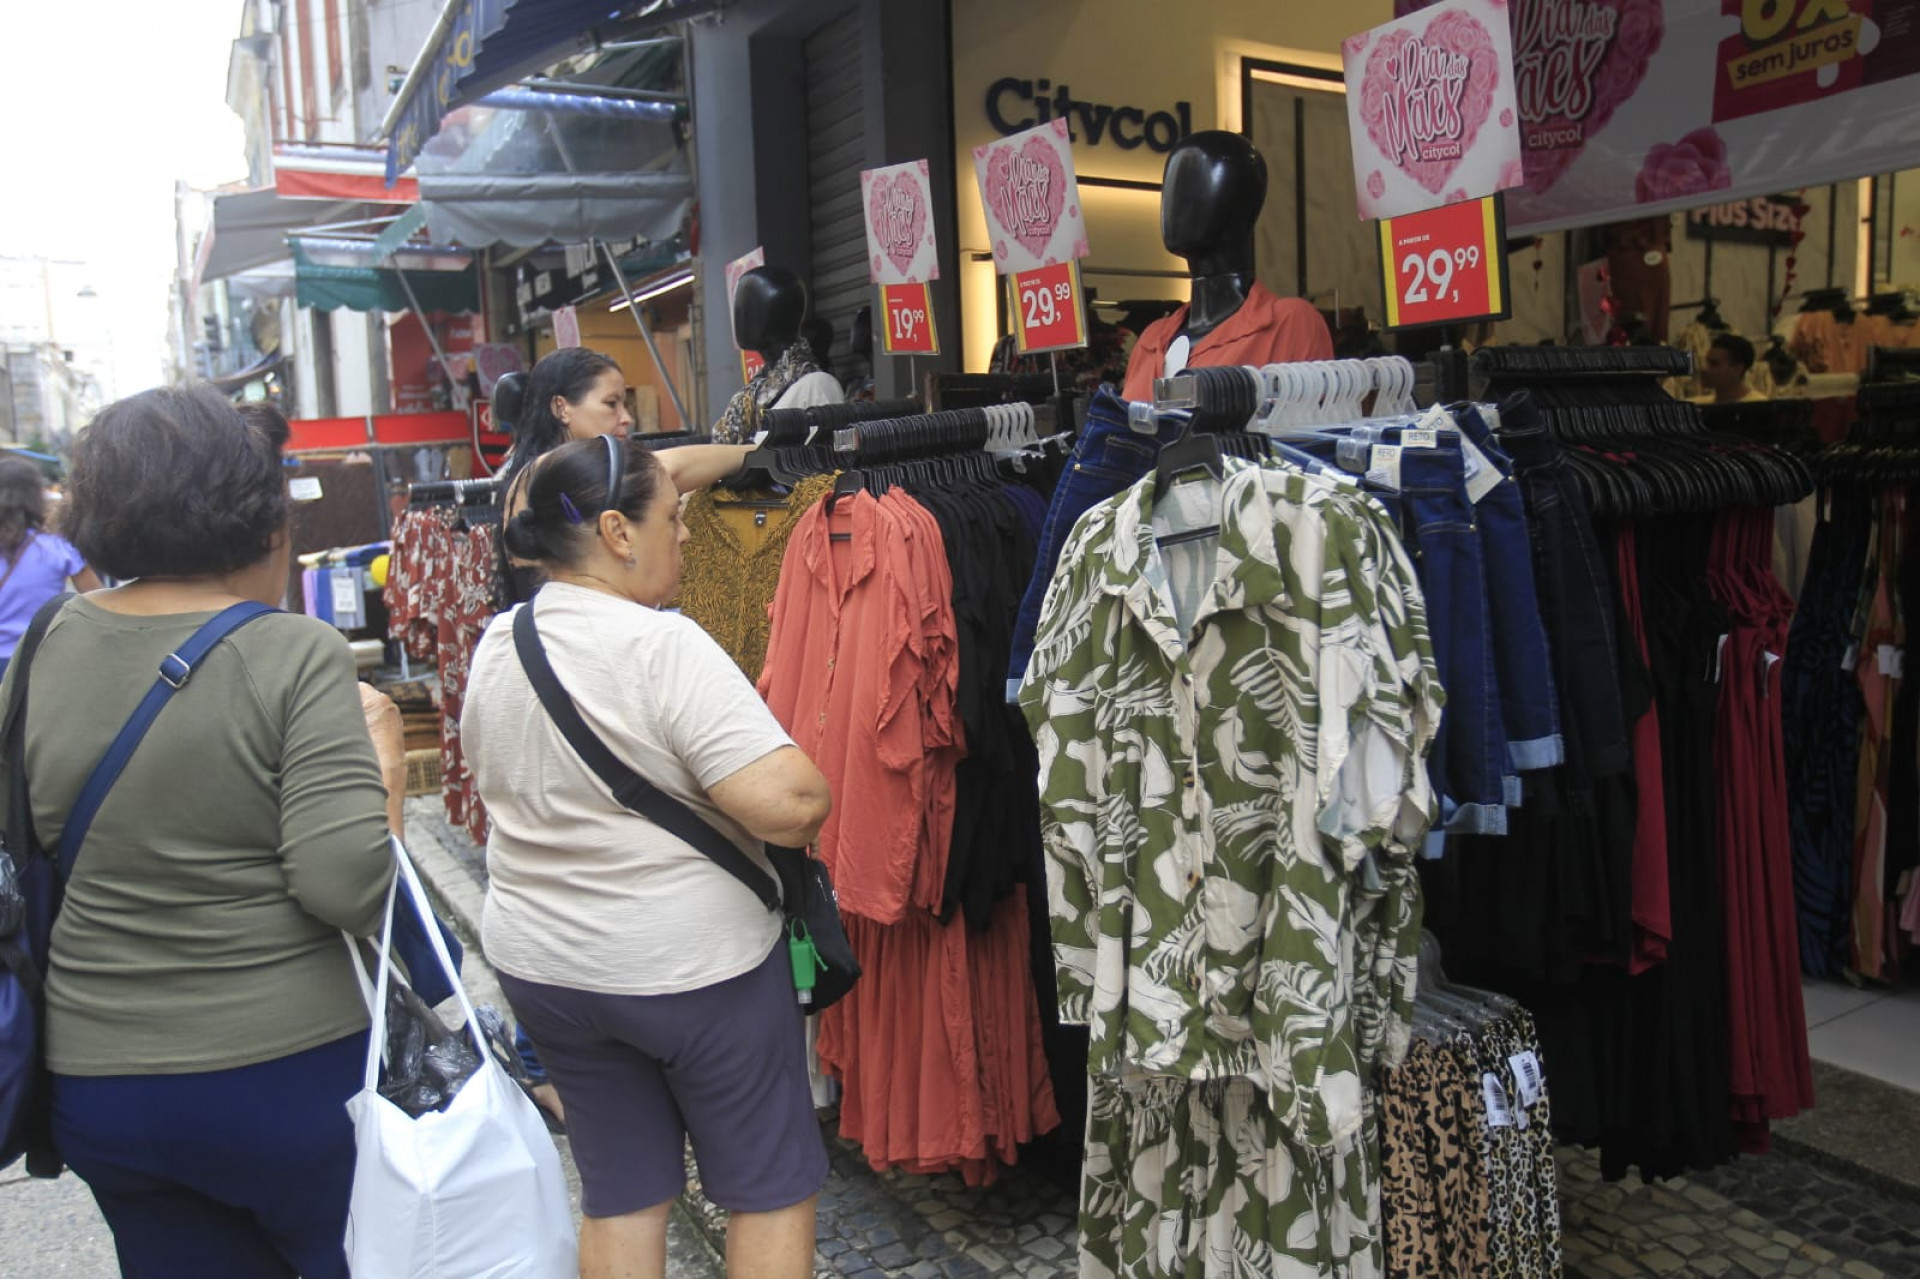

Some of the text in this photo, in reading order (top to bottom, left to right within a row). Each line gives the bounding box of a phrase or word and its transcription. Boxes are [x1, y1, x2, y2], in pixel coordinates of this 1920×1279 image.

[1736, 30, 1853, 81] sem juros
[1382, 79, 1463, 164] Mães
[1528, 124, 1583, 149] citycol
[1421, 144, 1461, 161] citycol
